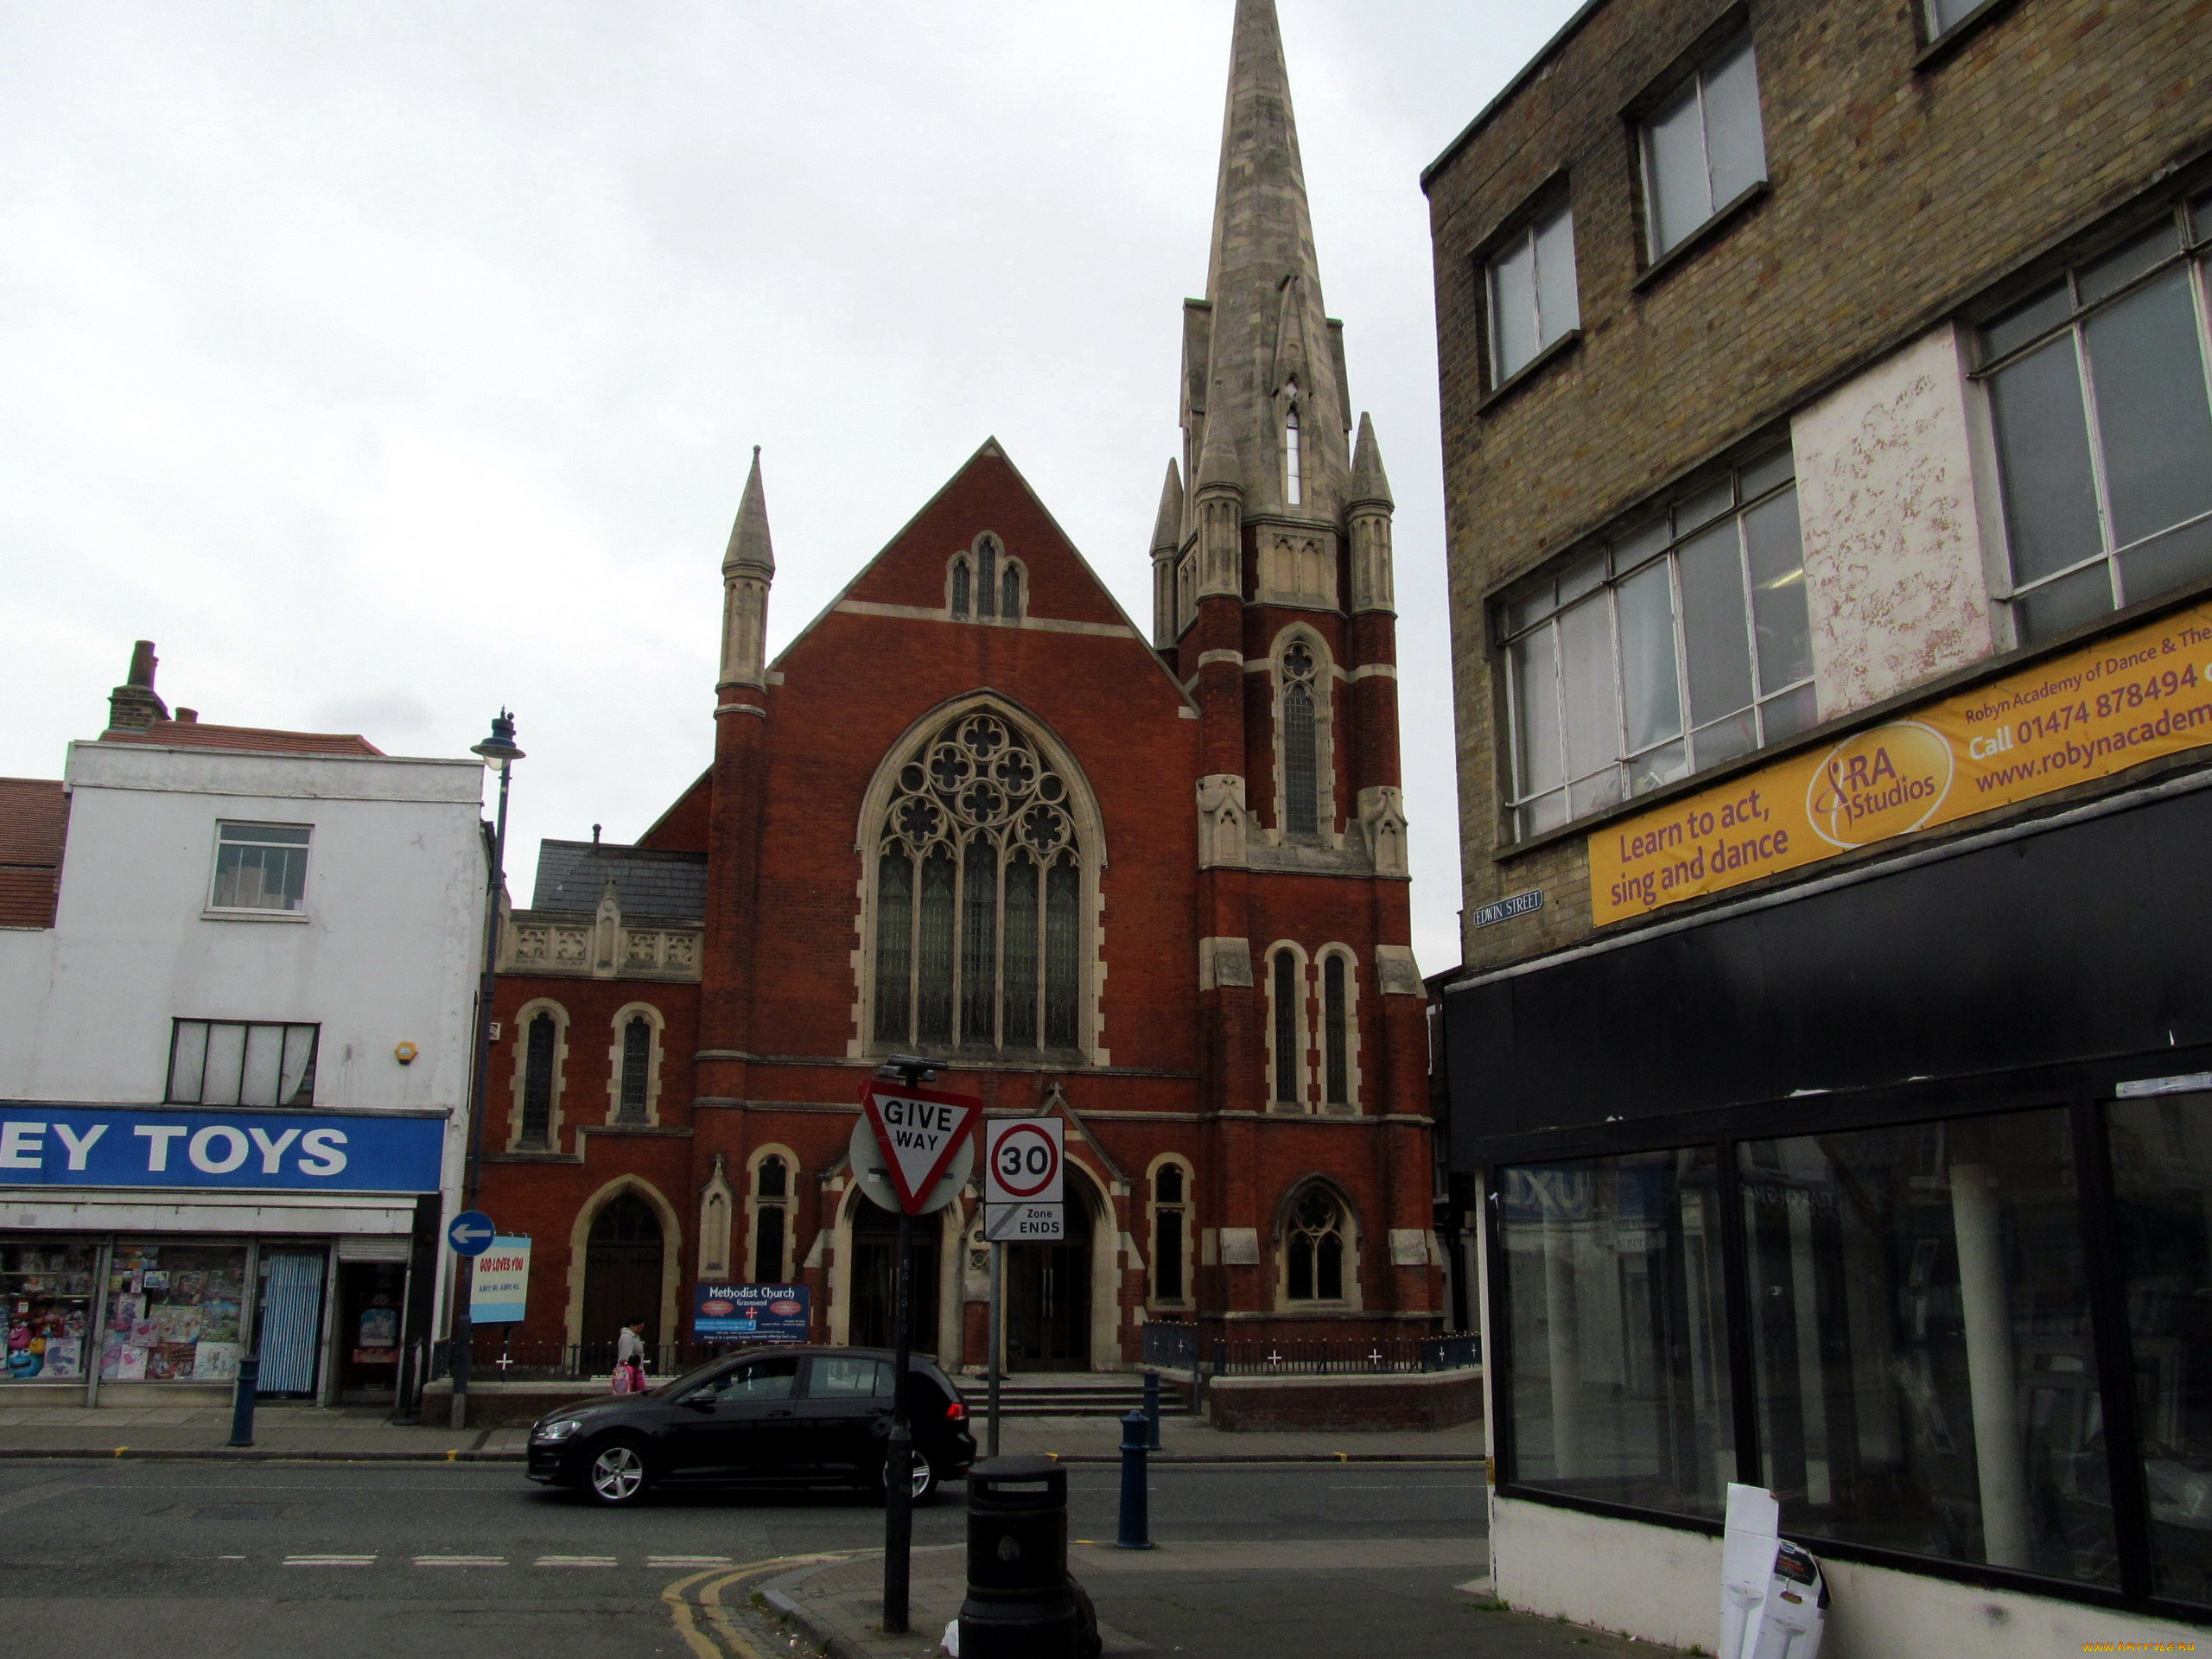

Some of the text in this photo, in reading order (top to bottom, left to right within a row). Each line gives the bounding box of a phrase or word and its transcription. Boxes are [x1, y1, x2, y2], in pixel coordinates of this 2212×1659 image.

[1966, 700, 2010, 724] Robyn
[2013, 674, 2082, 708] Academy
[2086, 662, 2101, 682] of
[2106, 647, 2157, 675] Dance
[2162, 638, 2177, 654] &
[1969, 664, 2198, 760] Call 01474 878494
[1847, 747, 1897, 791] RA
[1852, 775, 1936, 819] Studios
[1620, 789, 1770, 863] Learn to act,
[1611, 830, 1789, 906] sing and dance
[1477, 892, 1539, 925] EDWIN STREET
[884, 1100, 952, 1132] GIVE
[0, 1122, 348, 1176] EY TOYS
[896, 1130, 938, 1151] WAY
[1001, 1146, 1048, 1175] 30
[1020, 1222, 1060, 1233] ENDS
[1027, 1209, 1052, 1219] Zone
[480, 1256, 524, 1273] GOD LOVES YOU
[709, 1287, 795, 1300] Methodist Church
